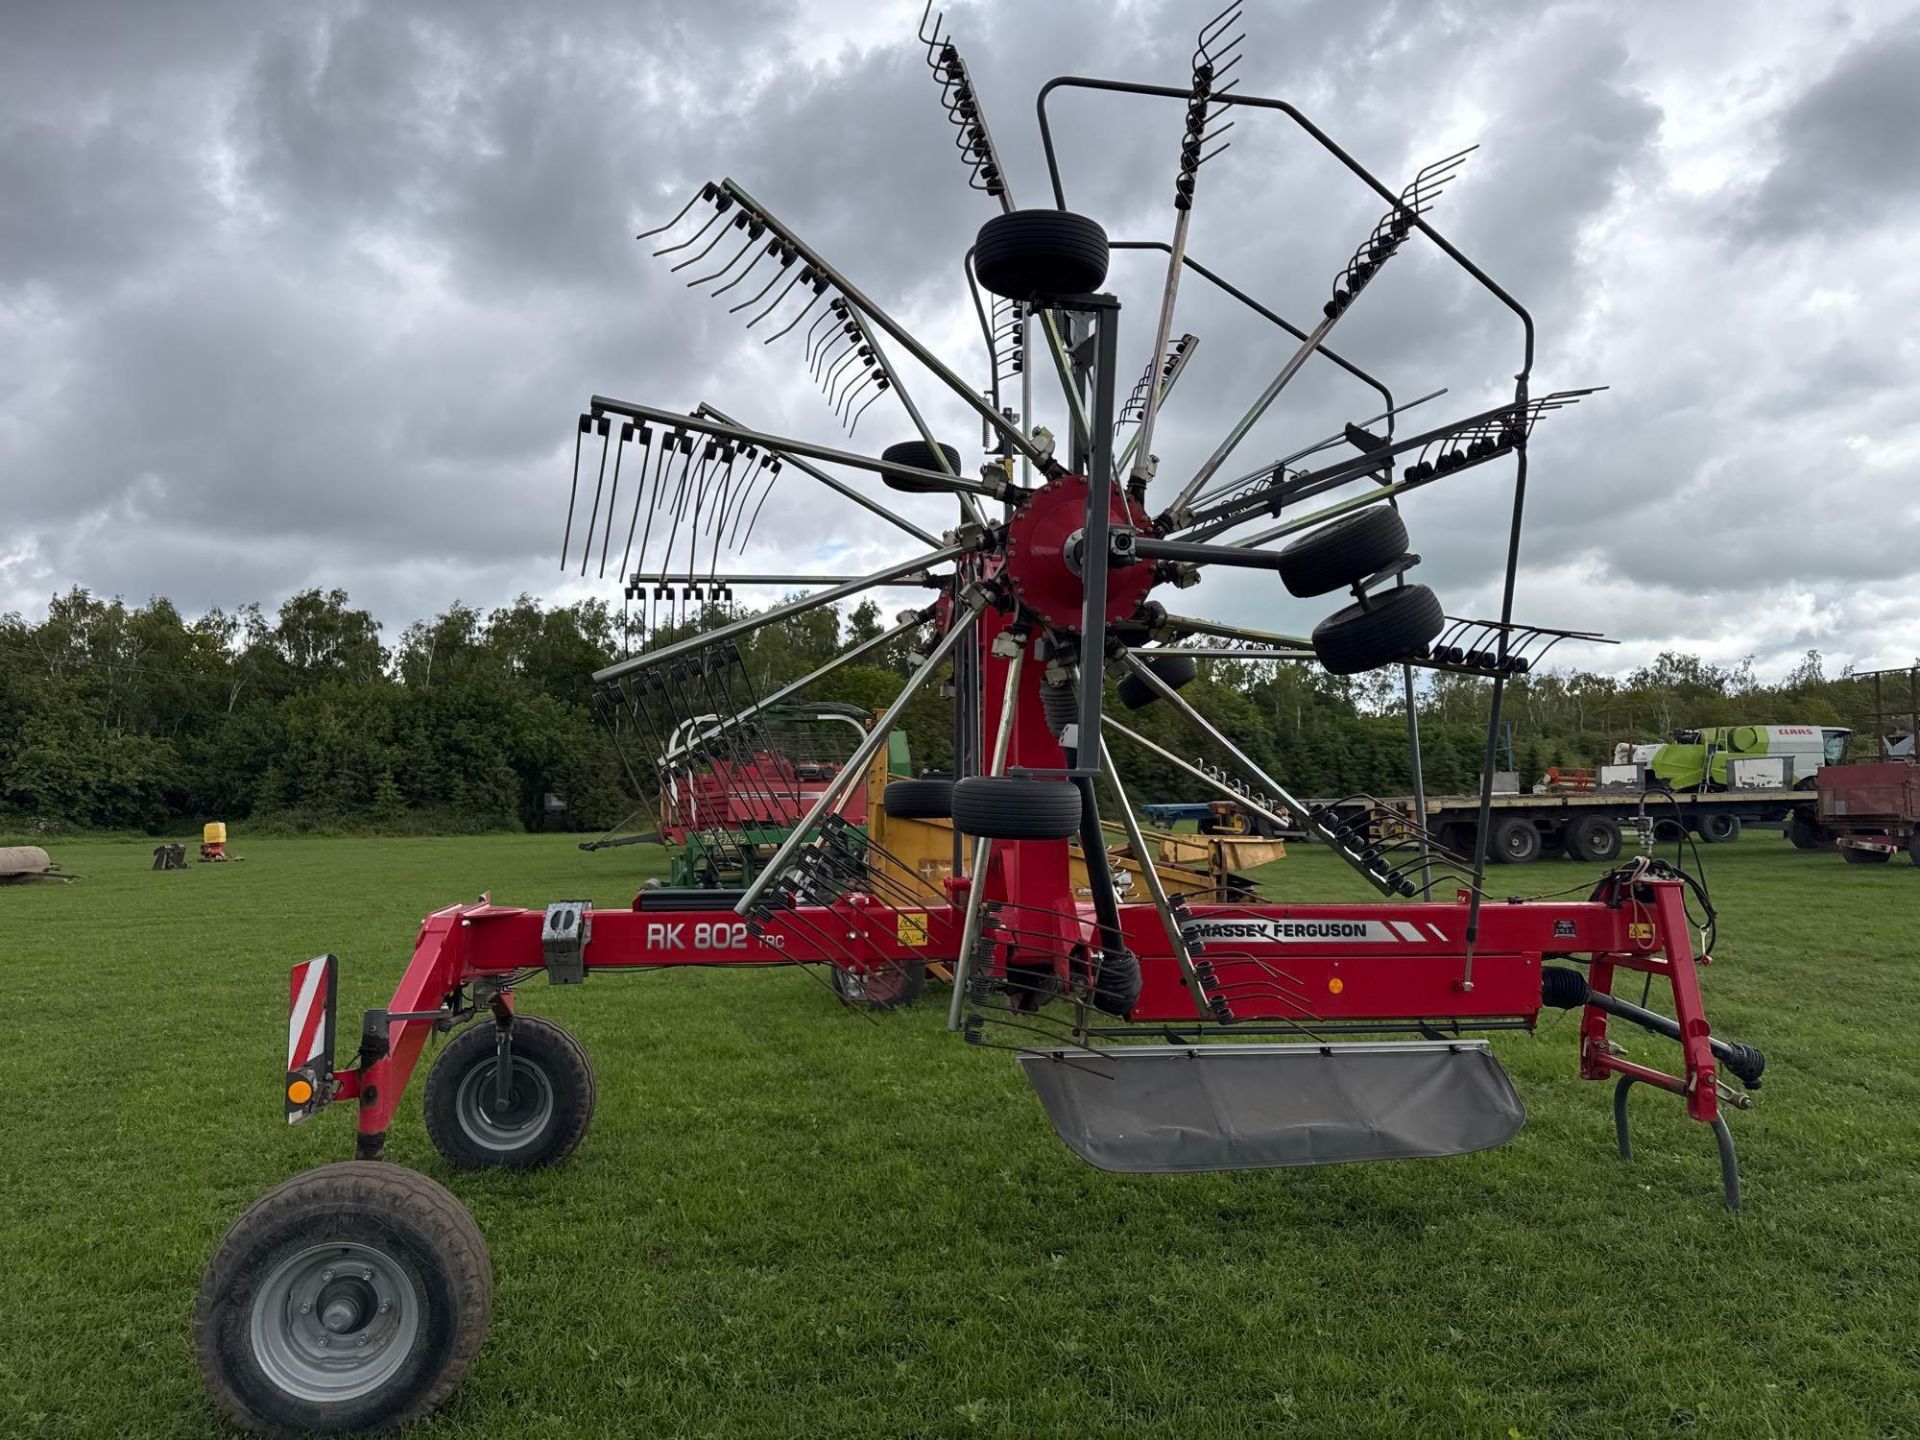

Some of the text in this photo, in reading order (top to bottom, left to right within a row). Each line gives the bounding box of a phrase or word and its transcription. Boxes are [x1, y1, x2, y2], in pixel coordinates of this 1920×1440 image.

[647, 923, 685, 949] RK
[694, 923, 747, 949] 802
[1196, 924, 1367, 938] MASSEY FERGUSON
